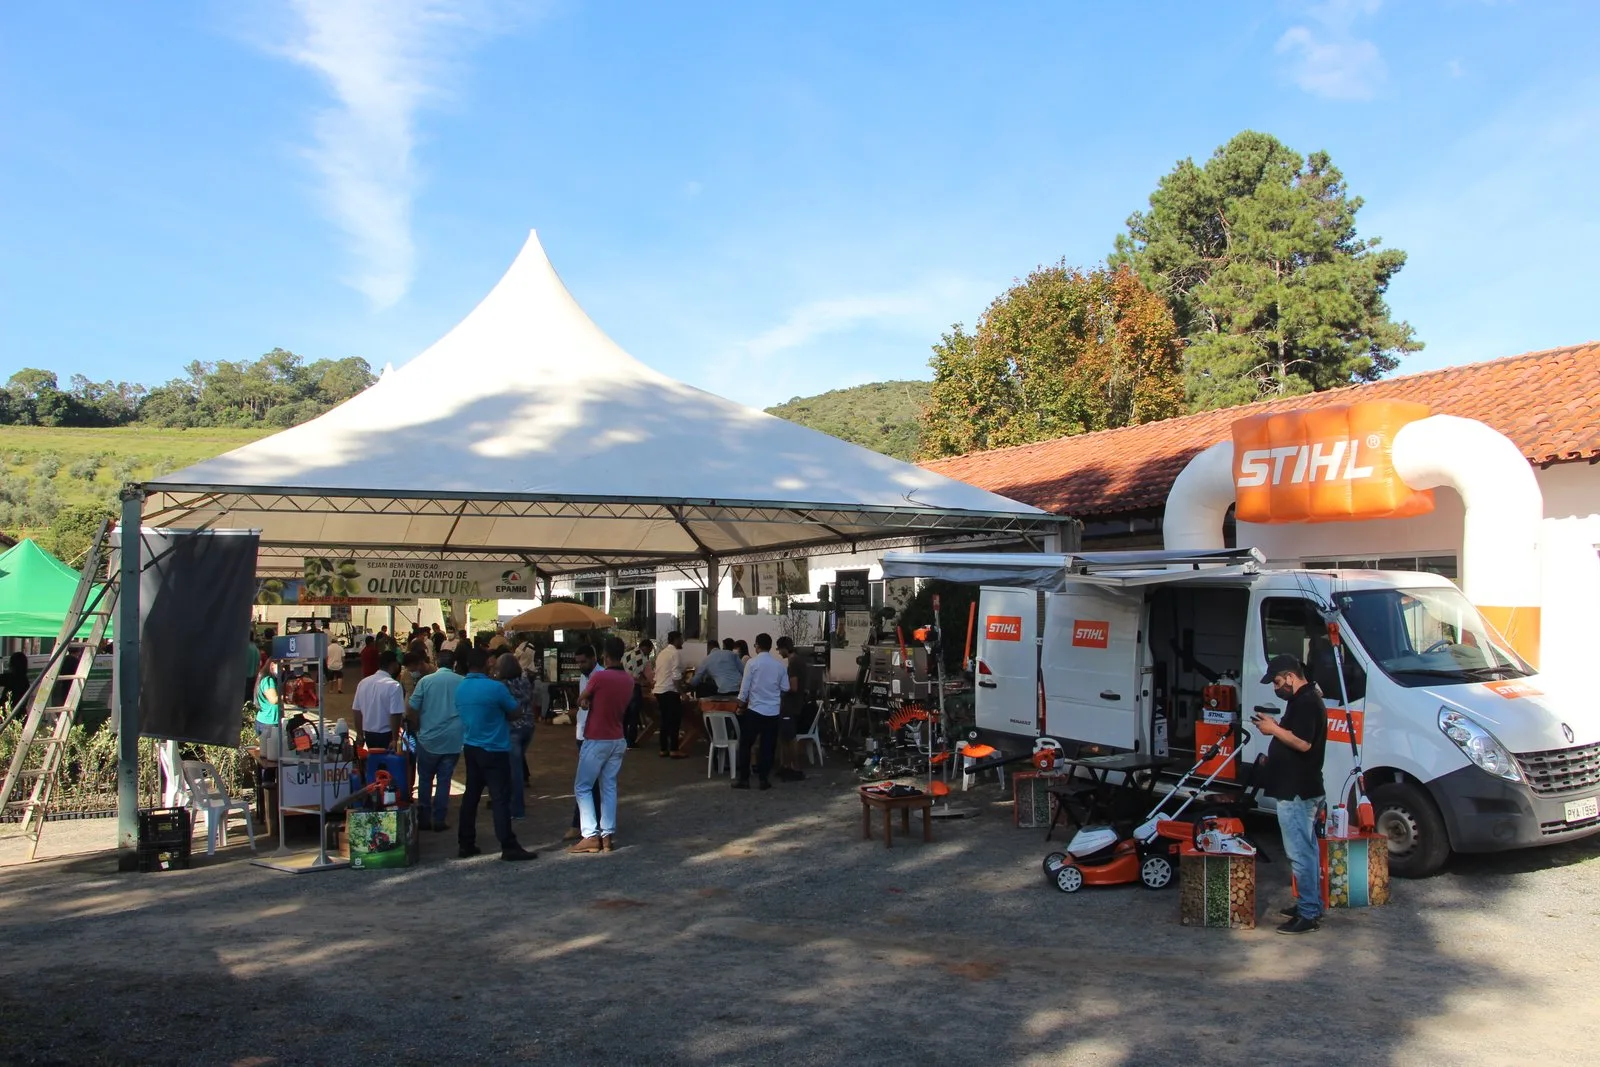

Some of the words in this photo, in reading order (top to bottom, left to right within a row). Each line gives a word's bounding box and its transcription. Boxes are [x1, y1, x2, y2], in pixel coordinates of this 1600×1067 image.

[392, 569, 407, 578] DIA
[409, 570, 421, 578] DE
[423, 570, 454, 579] CAMPO
[456, 571, 468, 579] DE
[367, 578, 481, 596] OLIVICULTURA
[989, 623, 1017, 634] STIHL
[1075, 628, 1105, 640] STIHL
